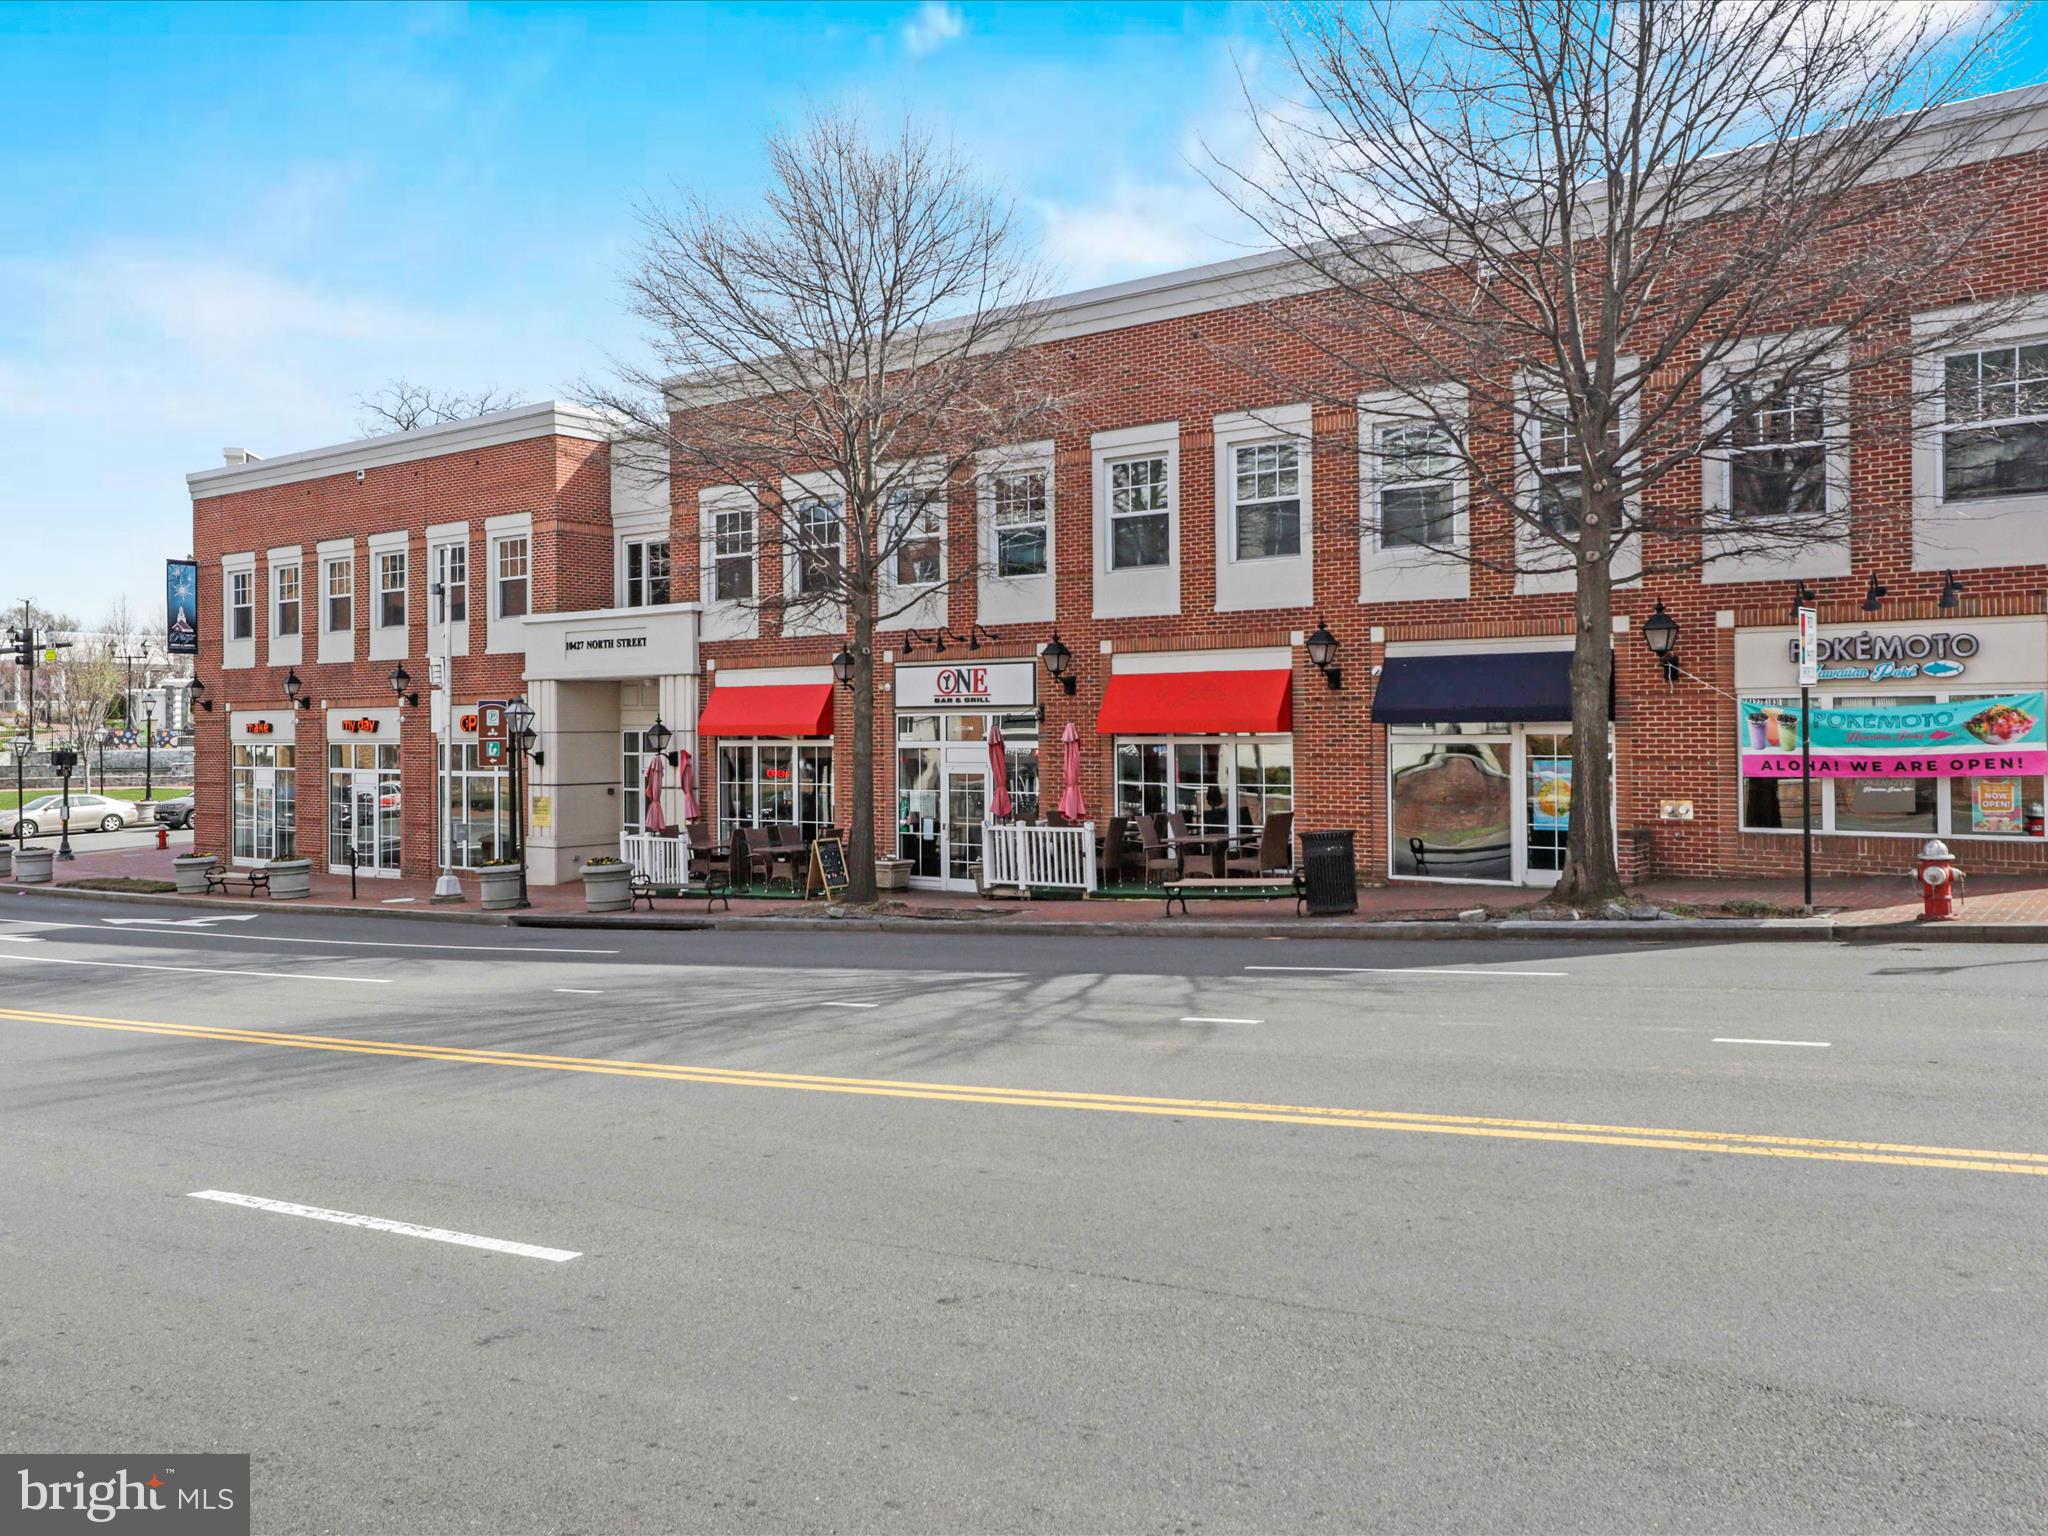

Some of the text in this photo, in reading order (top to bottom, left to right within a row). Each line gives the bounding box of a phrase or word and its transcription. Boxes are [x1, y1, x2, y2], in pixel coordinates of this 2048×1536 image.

[586, 639, 614, 650] NORTH
[616, 637, 647, 648] STREET
[1816, 664, 1869, 681] awaiian
[1869, 661, 1919, 683] Poké
[937, 668, 988, 695] ONE
[246, 720, 270, 733] make
[342, 718, 377, 733] my day
[460, 714, 478, 733] CP
[1850, 761, 1882, 771] WE
[1894, 760, 1938, 771] ARE
[1950, 757, 2023, 770] OPEN!
[766, 769, 788, 778] OPEN
[1982, 800, 2010, 808] OPEN!
